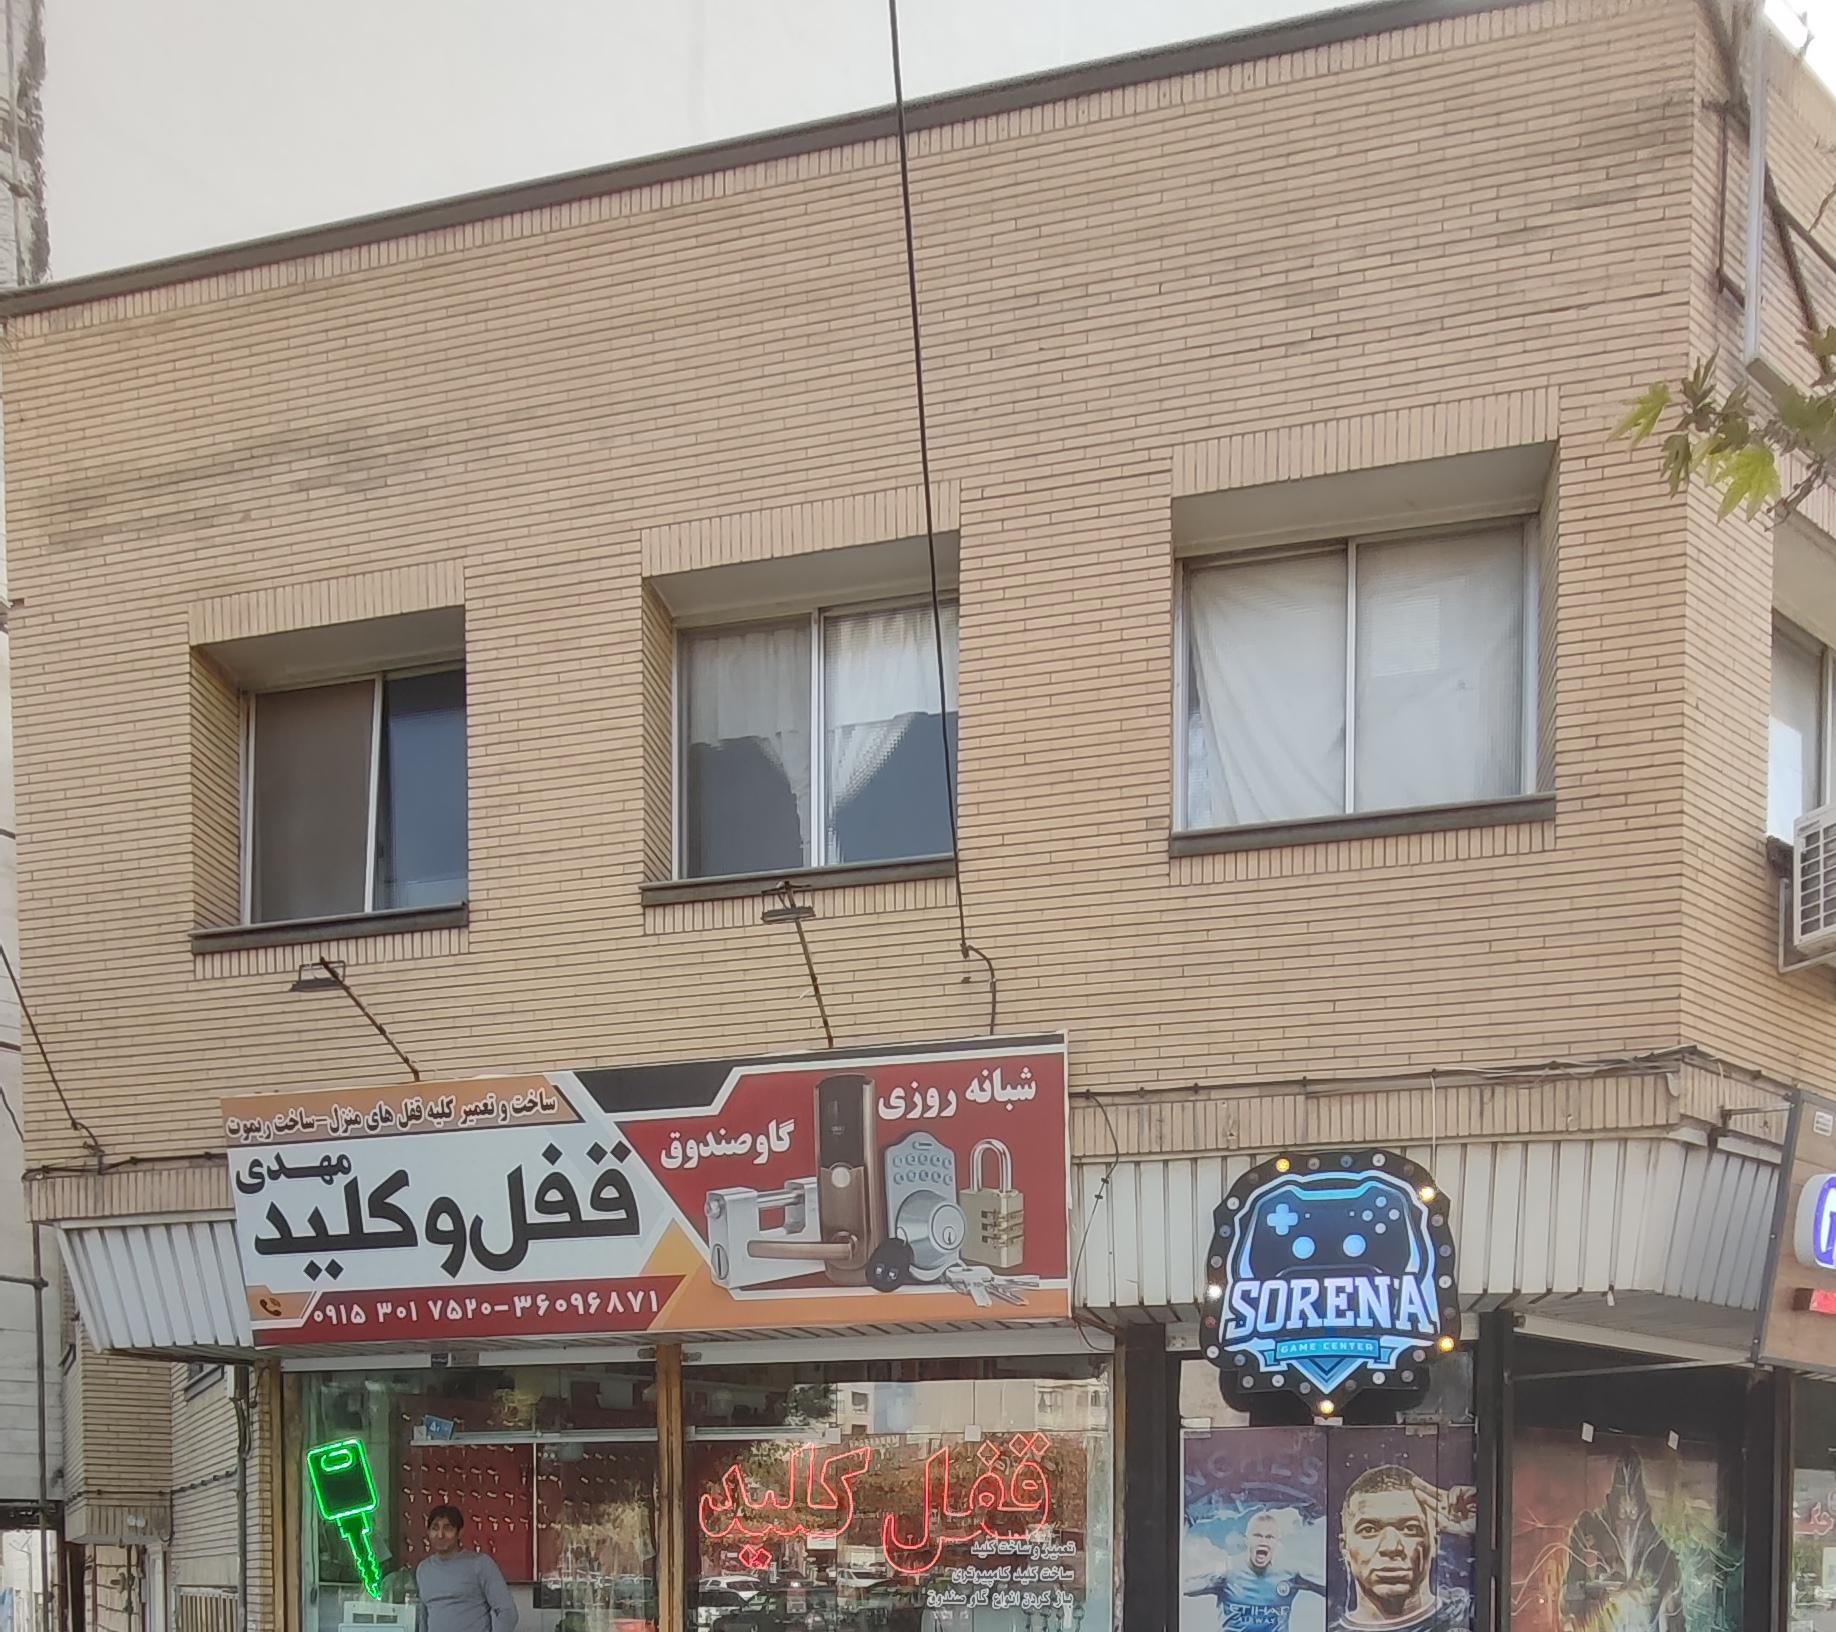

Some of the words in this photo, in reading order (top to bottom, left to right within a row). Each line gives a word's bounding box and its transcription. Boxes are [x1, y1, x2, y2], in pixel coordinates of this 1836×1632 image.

[512, 1087, 557, 1117] ساخت
[877, 1080, 957, 1121] روزی
[964, 1066, 1036, 1112] شبانه
[365, 1101, 394, 1132] های
[397, 1097, 424, 1130] قفل
[427, 1096, 455, 1126] کلیه
[458, 1093, 496, 1126] تعمیر
[498, 1100, 510, 1123] و
[227, 1116, 273, 1142] ریموت
[235, 1151, 353, 1195] مهدی
[469, 1139, 642, 1272] قفل
[254, 1168, 419, 1282] کلید
[424, 1195, 468, 1279] و
[1226, 1275, 1437, 1340] SORENA
[1280, 1341, 1317, 1354] GAME
[1323, 1340, 1374, 1353] CENTER
[699, 1442, 872, 1570] کلید
[882, 1432, 1052, 1574] قفل
[1013, 1567, 1038, 1584] کلید
[1040, 1564, 1074, 1581] ساخت
